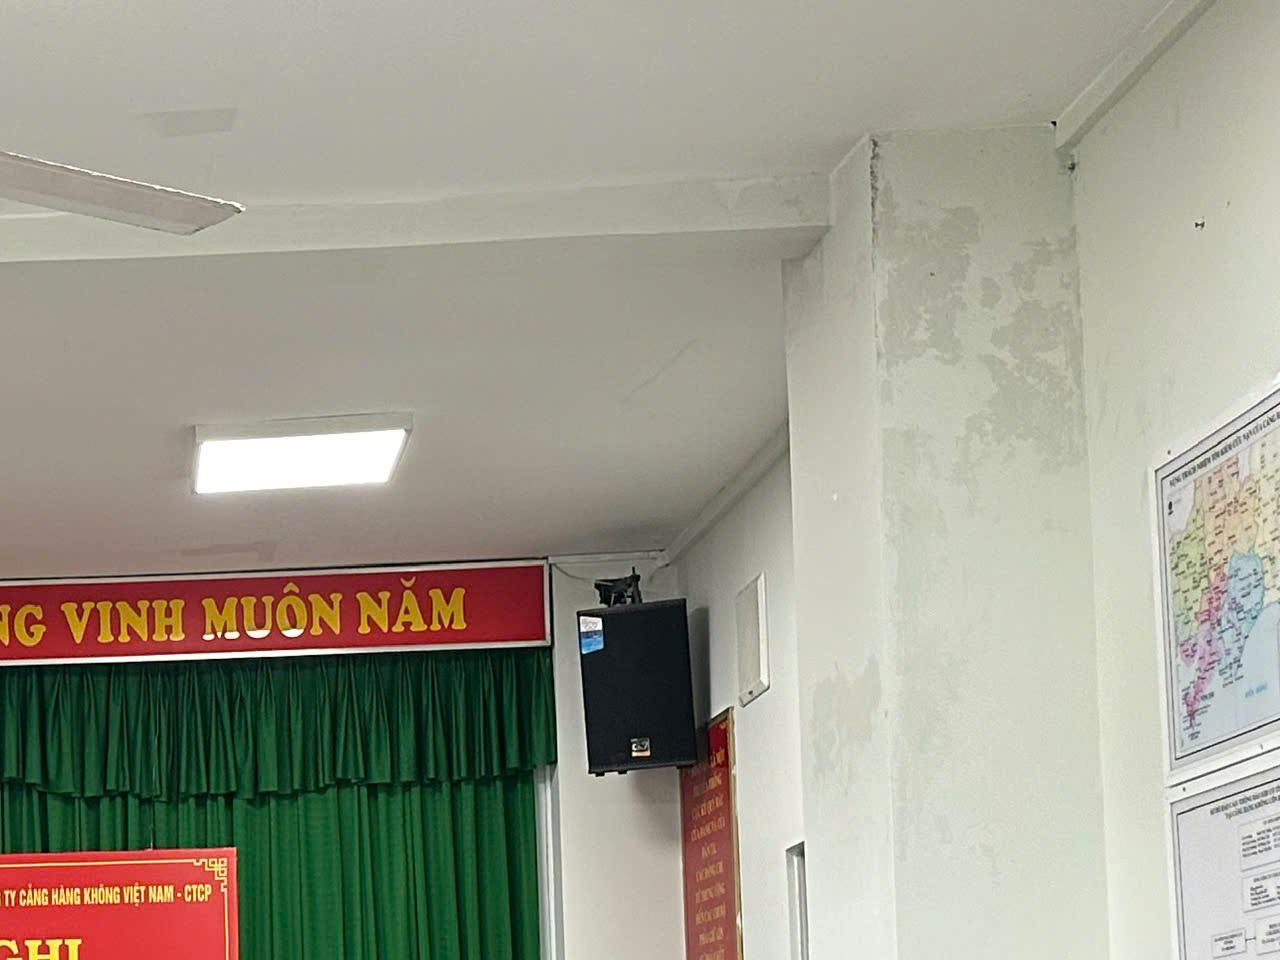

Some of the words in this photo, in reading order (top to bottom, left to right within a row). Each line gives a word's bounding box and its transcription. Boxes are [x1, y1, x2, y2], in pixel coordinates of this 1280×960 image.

[60, 597, 187, 646] VINH
[201, 582, 343, 641] MUÔN
[354, 576, 468, 634] NĂM
[4, 889, 16, 907] TY
[51, 885, 81, 906] HÀNG
[83, 883, 121, 905] KHÔNG
[123, 881, 147, 908] VIỆT
[148, 885, 174, 904] NAM
[184, 884, 212, 902] CTCP
